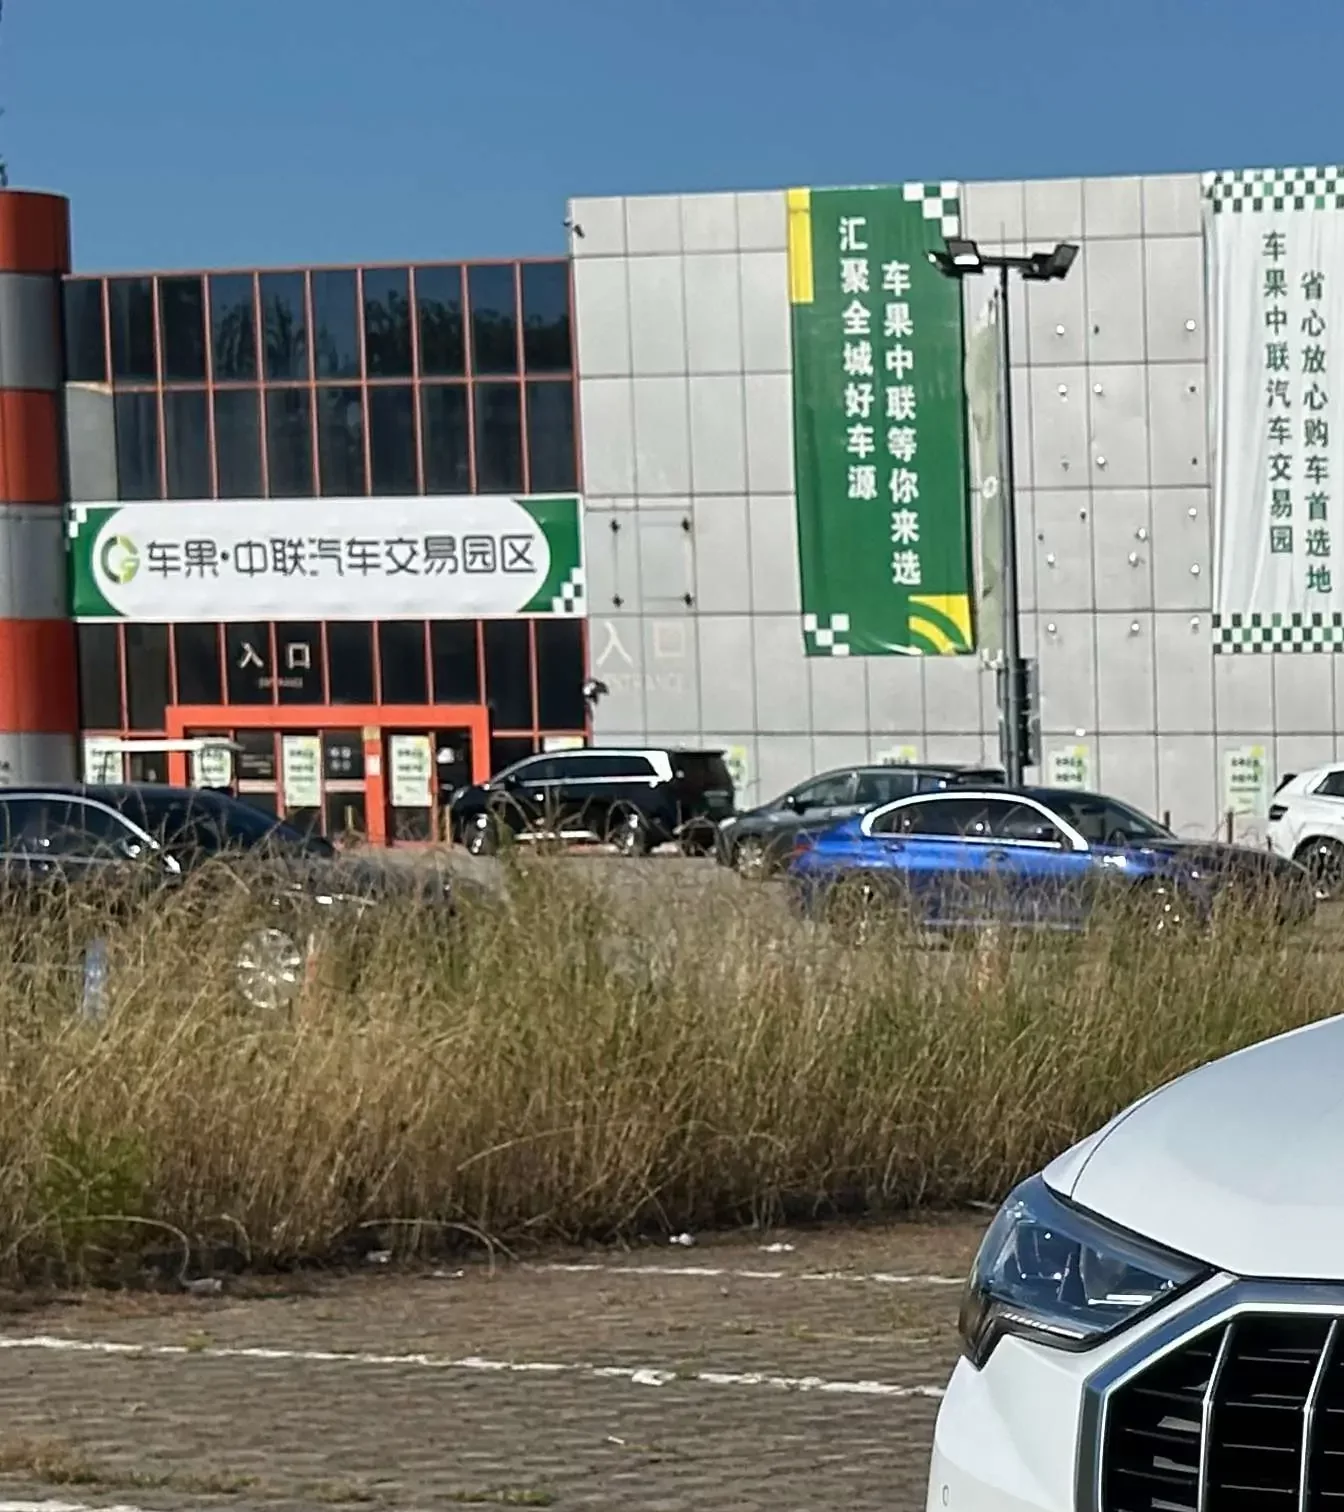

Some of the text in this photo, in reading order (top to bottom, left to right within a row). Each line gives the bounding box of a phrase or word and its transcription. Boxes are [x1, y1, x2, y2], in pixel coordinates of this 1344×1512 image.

[838, 216, 878, 500] 汇聚全城好车源
[882, 260, 922, 585] 车果中联等你来选
[1262, 230, 1294, 554] 车果中联汽车交易园
[1301, 270, 1333, 594] 省心放心购车首选地
[146, 533, 538, 579] 车果·中联汽车交易园区
[238, 641, 311, 670] 入口
[596, 620, 686, 668] 入口
